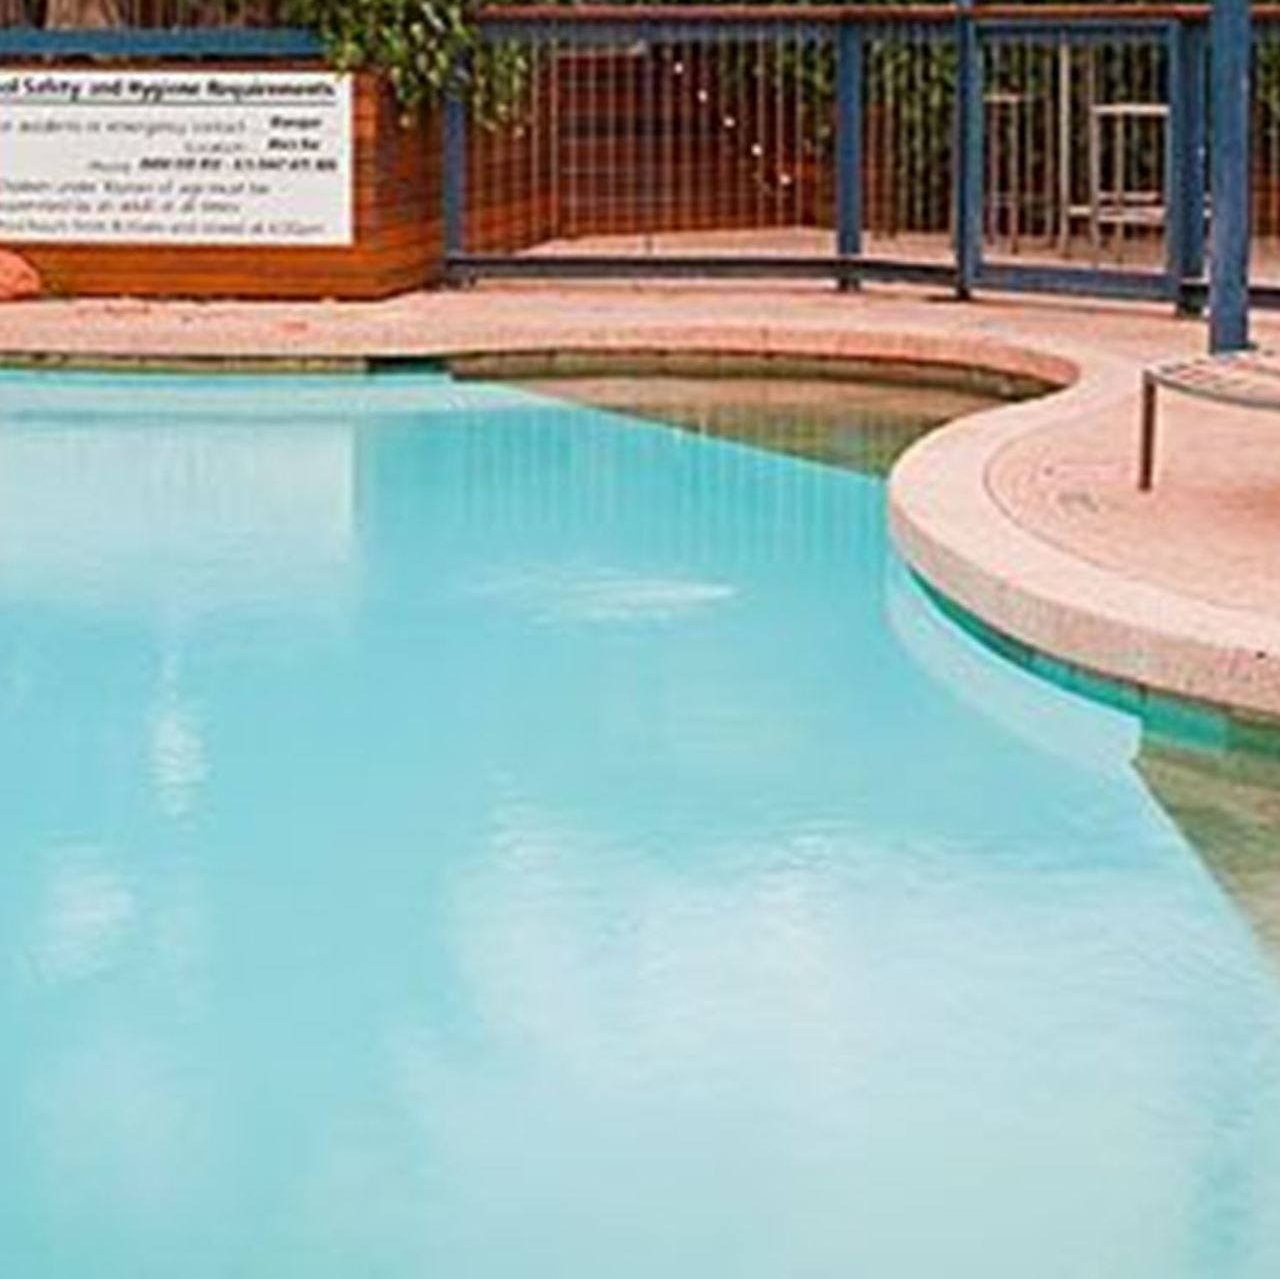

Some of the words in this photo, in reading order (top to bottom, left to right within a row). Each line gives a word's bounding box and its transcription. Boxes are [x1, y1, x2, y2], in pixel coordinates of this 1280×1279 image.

[23, 77, 81, 104] Safety
[90, 79, 121, 96] and
[129, 79, 198, 103] Hygiene
[207, 77, 335, 105] Requirements
[106, 120, 186, 137] emergency
